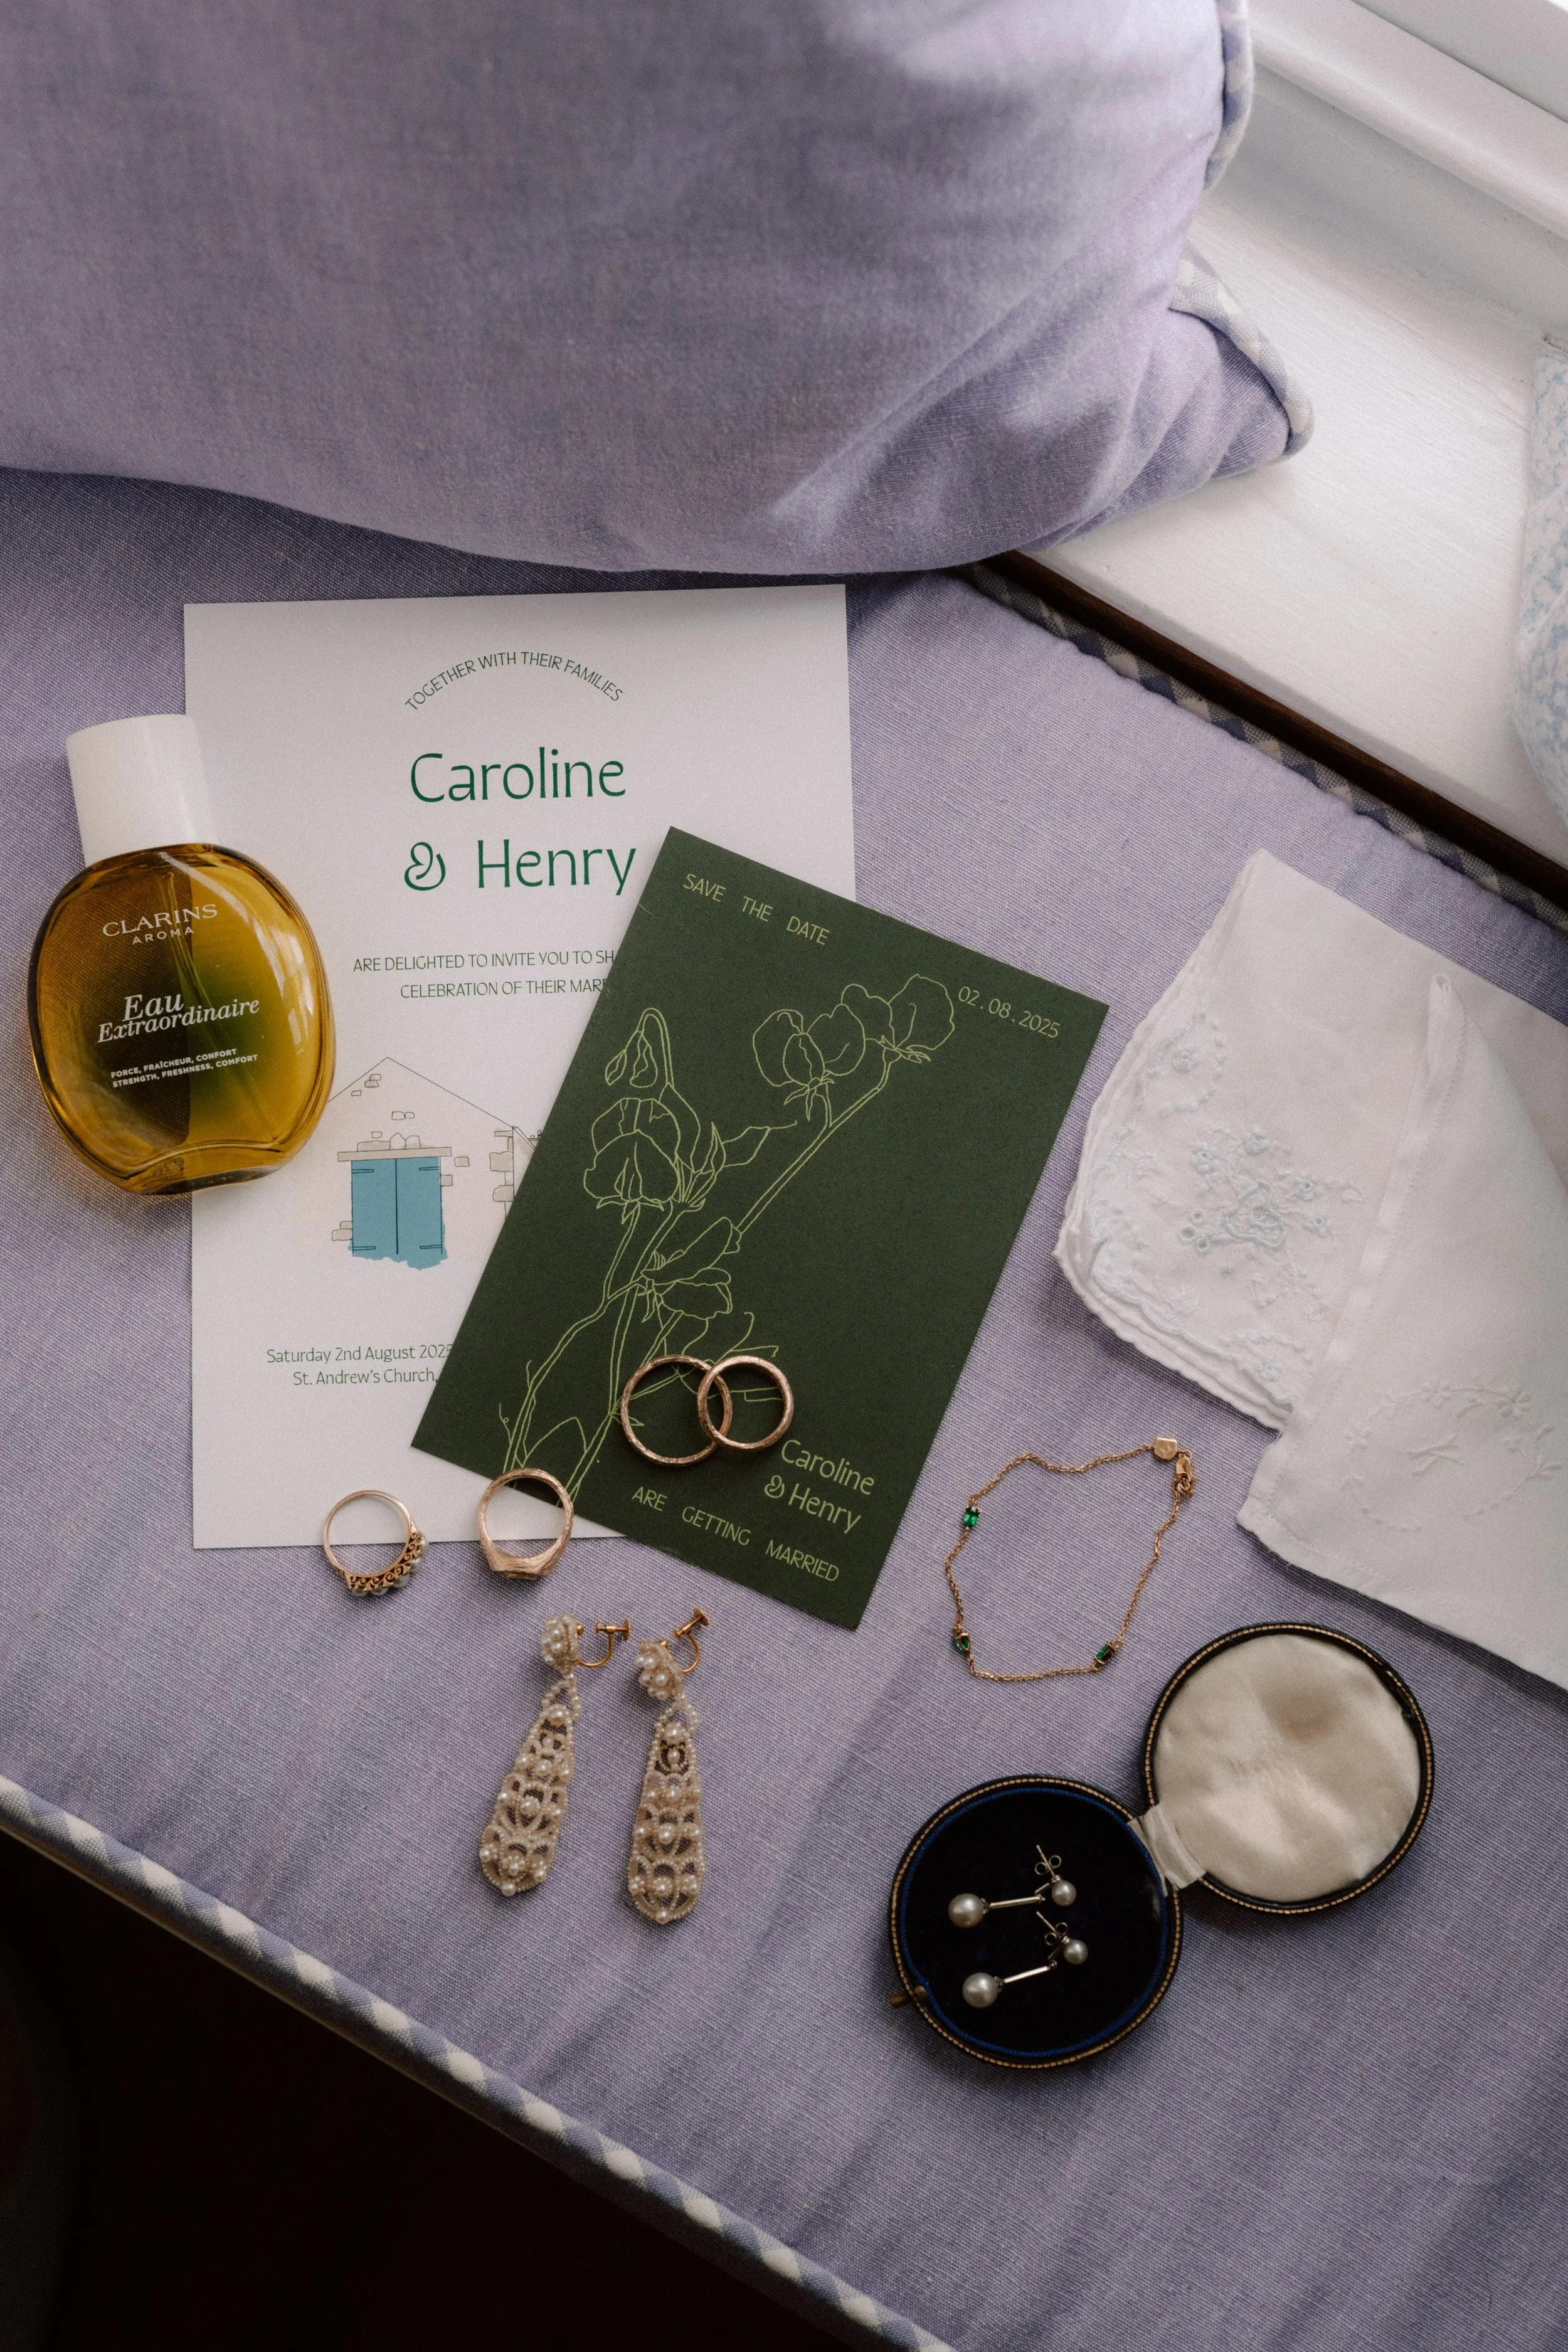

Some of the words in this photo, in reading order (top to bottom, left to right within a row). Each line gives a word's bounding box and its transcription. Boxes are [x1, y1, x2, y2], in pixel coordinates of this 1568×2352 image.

[405, 660, 477, 710] TOGETHER
[478, 651, 516, 669] WITH
[521, 651, 563, 670] THEIR
[564, 659, 623, 701] FAMILIES
[410, 746, 626, 803] Caroline
[404, 842, 446, 891] &
[477, 839, 637, 896] Henry
[102, 904, 218, 936] CLARINS
[683, 874, 726, 903] SAVE
[742, 896, 773, 922] THE
[787, 916, 830, 945] DATE
[132, 926, 194, 945] AROMA
[353, 958, 381, 972] ARE
[384, 955, 465, 970] DELIGHTED
[469, 953, 488, 968] TO
[492, 952, 535, 967] INVITE
[539, 951, 568, 965] YOU
[572, 950, 593, 964] TO
[400, 982, 498, 999] CELEBRATION
[502, 981, 522, 995] OF
[526, 980, 566, 994] THEIR
[97, 999, 260, 1044] Extraordinaire
[122, 994, 184, 1022] Eau
[111, 1066, 142, 1078] FORCE,
[196, 1048, 237, 1062] CONFORT
[112, 1074, 160, 1088] STRENGTH,
[162, 1063, 214, 1078] FRESHNESS,
[216, 1054, 258, 1067] COMFORT
[267, 1348, 331, 1364] Saturday
[335, 1346, 361, 1361] 2nd
[365, 1347, 415, 1362] August
[293, 1372, 313, 1385] St.
[781, 1439, 875, 1495] Caroline
[764, 1475, 785, 1498] &
[788, 1483, 862, 1534] Henry
[632, 1486, 668, 1512] ARE
[682, 1507, 752, 1546] GETTING
[765, 1540, 839, 1582] MARRIED
